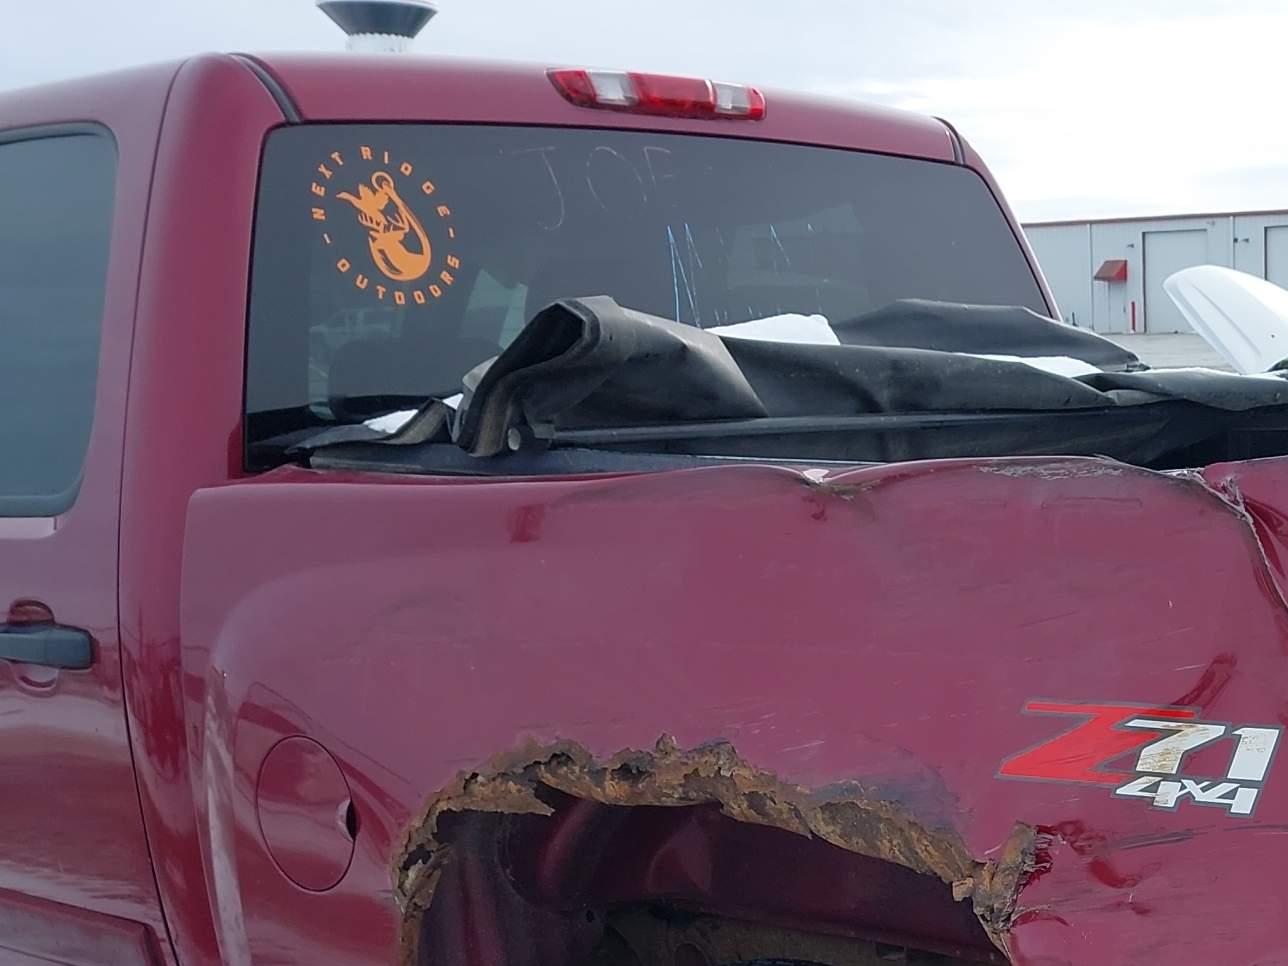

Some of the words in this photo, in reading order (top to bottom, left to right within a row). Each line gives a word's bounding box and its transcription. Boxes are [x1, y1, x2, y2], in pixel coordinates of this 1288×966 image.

[311, 152, 343, 220] NEXT
[361, 146, 450, 217] RIDGE
[336, 255, 460, 304] OUTDOORS
[1000, 702, 1279, 783] Z71
